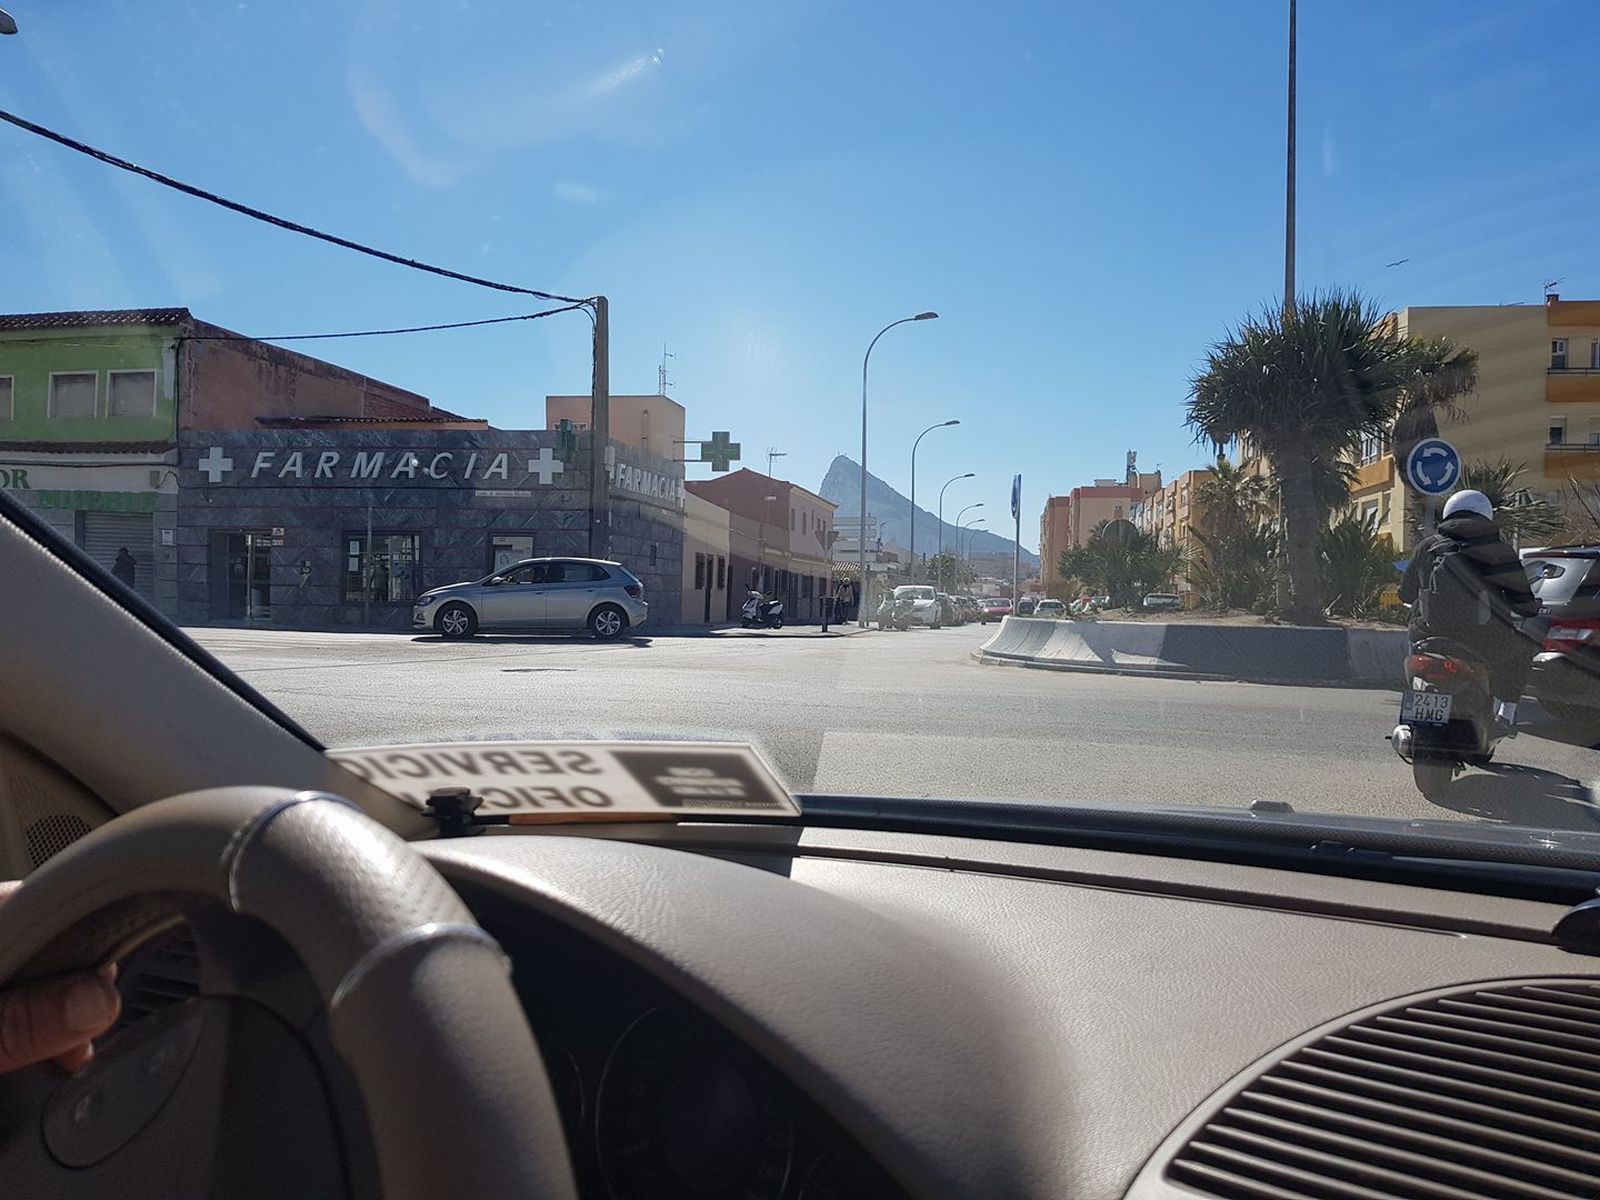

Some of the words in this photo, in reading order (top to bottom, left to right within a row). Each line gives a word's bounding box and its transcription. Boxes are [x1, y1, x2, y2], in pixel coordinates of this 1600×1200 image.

[251, 451, 509, 480] FARMACIA
[615, 463, 676, 502] FARMACIA
[1415, 694, 1449, 709] 2413
[1415, 708, 1444, 721] HMG
